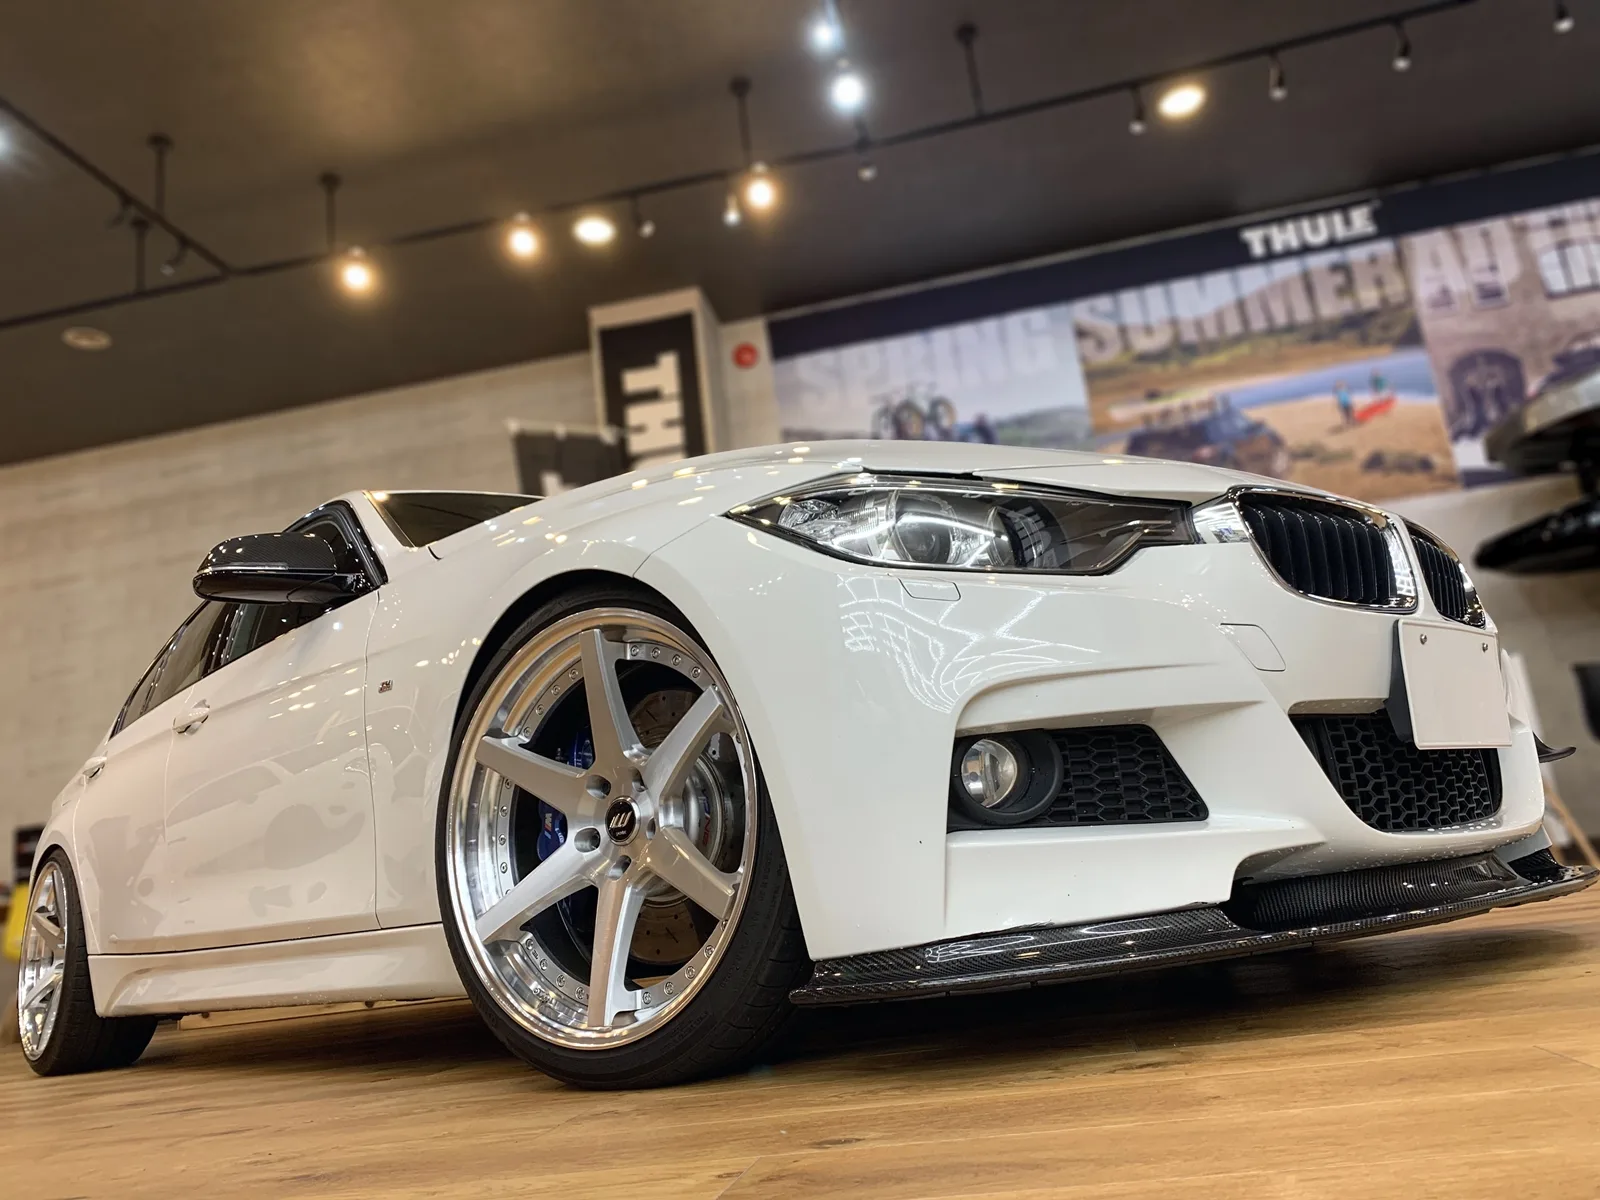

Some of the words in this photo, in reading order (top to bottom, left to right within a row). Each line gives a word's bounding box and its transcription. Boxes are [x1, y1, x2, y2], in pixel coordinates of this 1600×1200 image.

[1240, 204, 1377, 258] THULE
[795, 308, 1060, 413] SPRING
[1070, 242, 1412, 364] SUMMER
